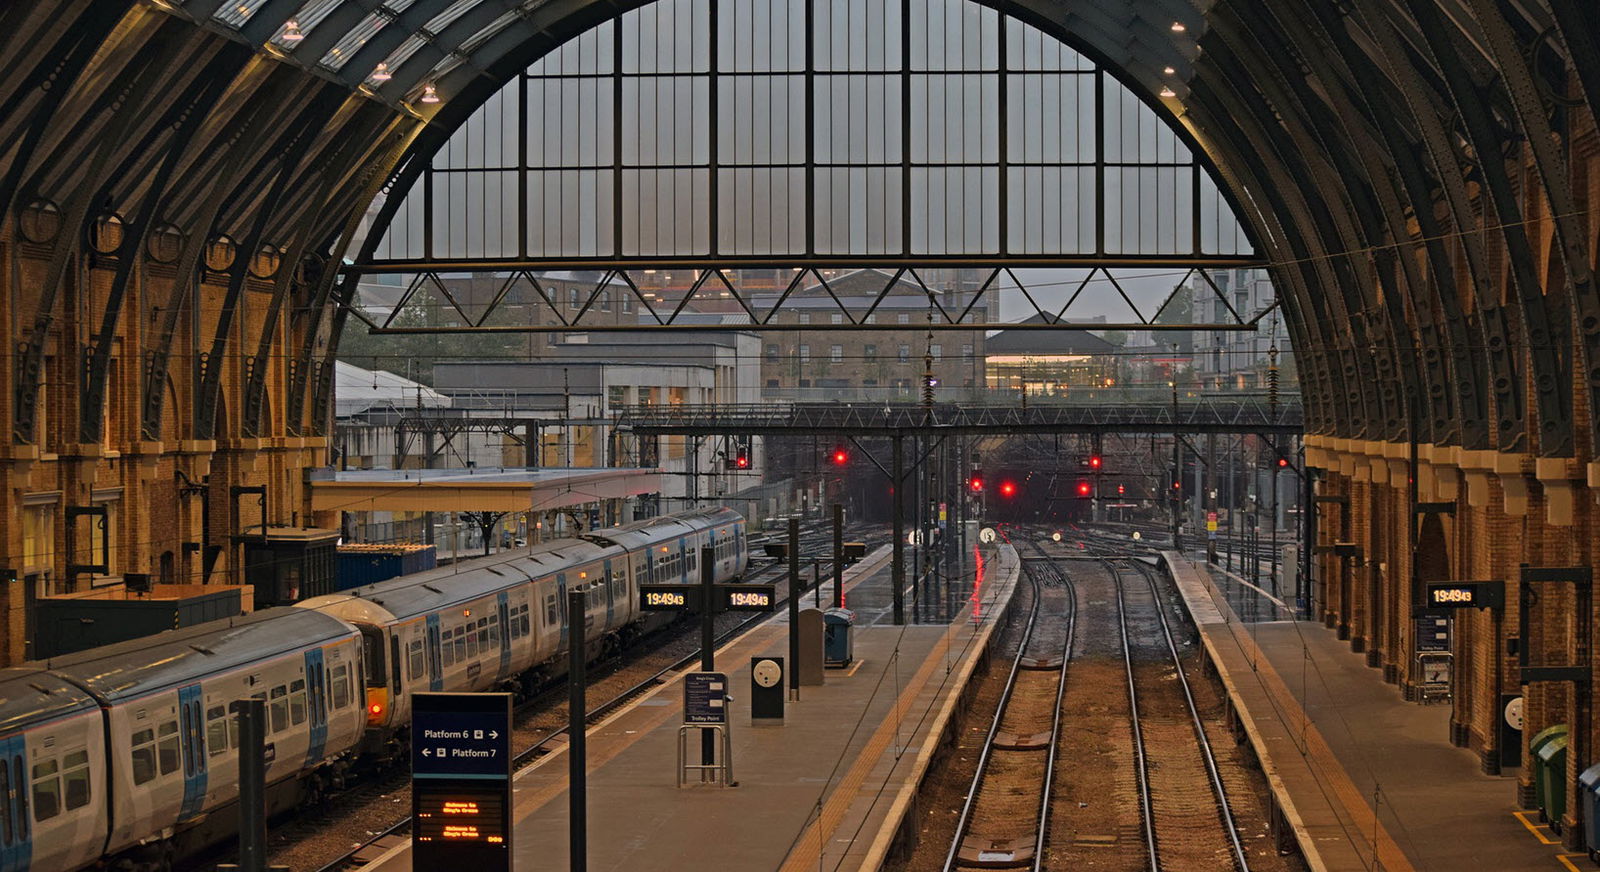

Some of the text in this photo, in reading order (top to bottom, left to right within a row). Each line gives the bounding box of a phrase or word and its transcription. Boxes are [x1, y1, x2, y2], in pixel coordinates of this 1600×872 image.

[424, 730, 469, 738] Platform 6
[452, 749, 496, 757] Platform 7
